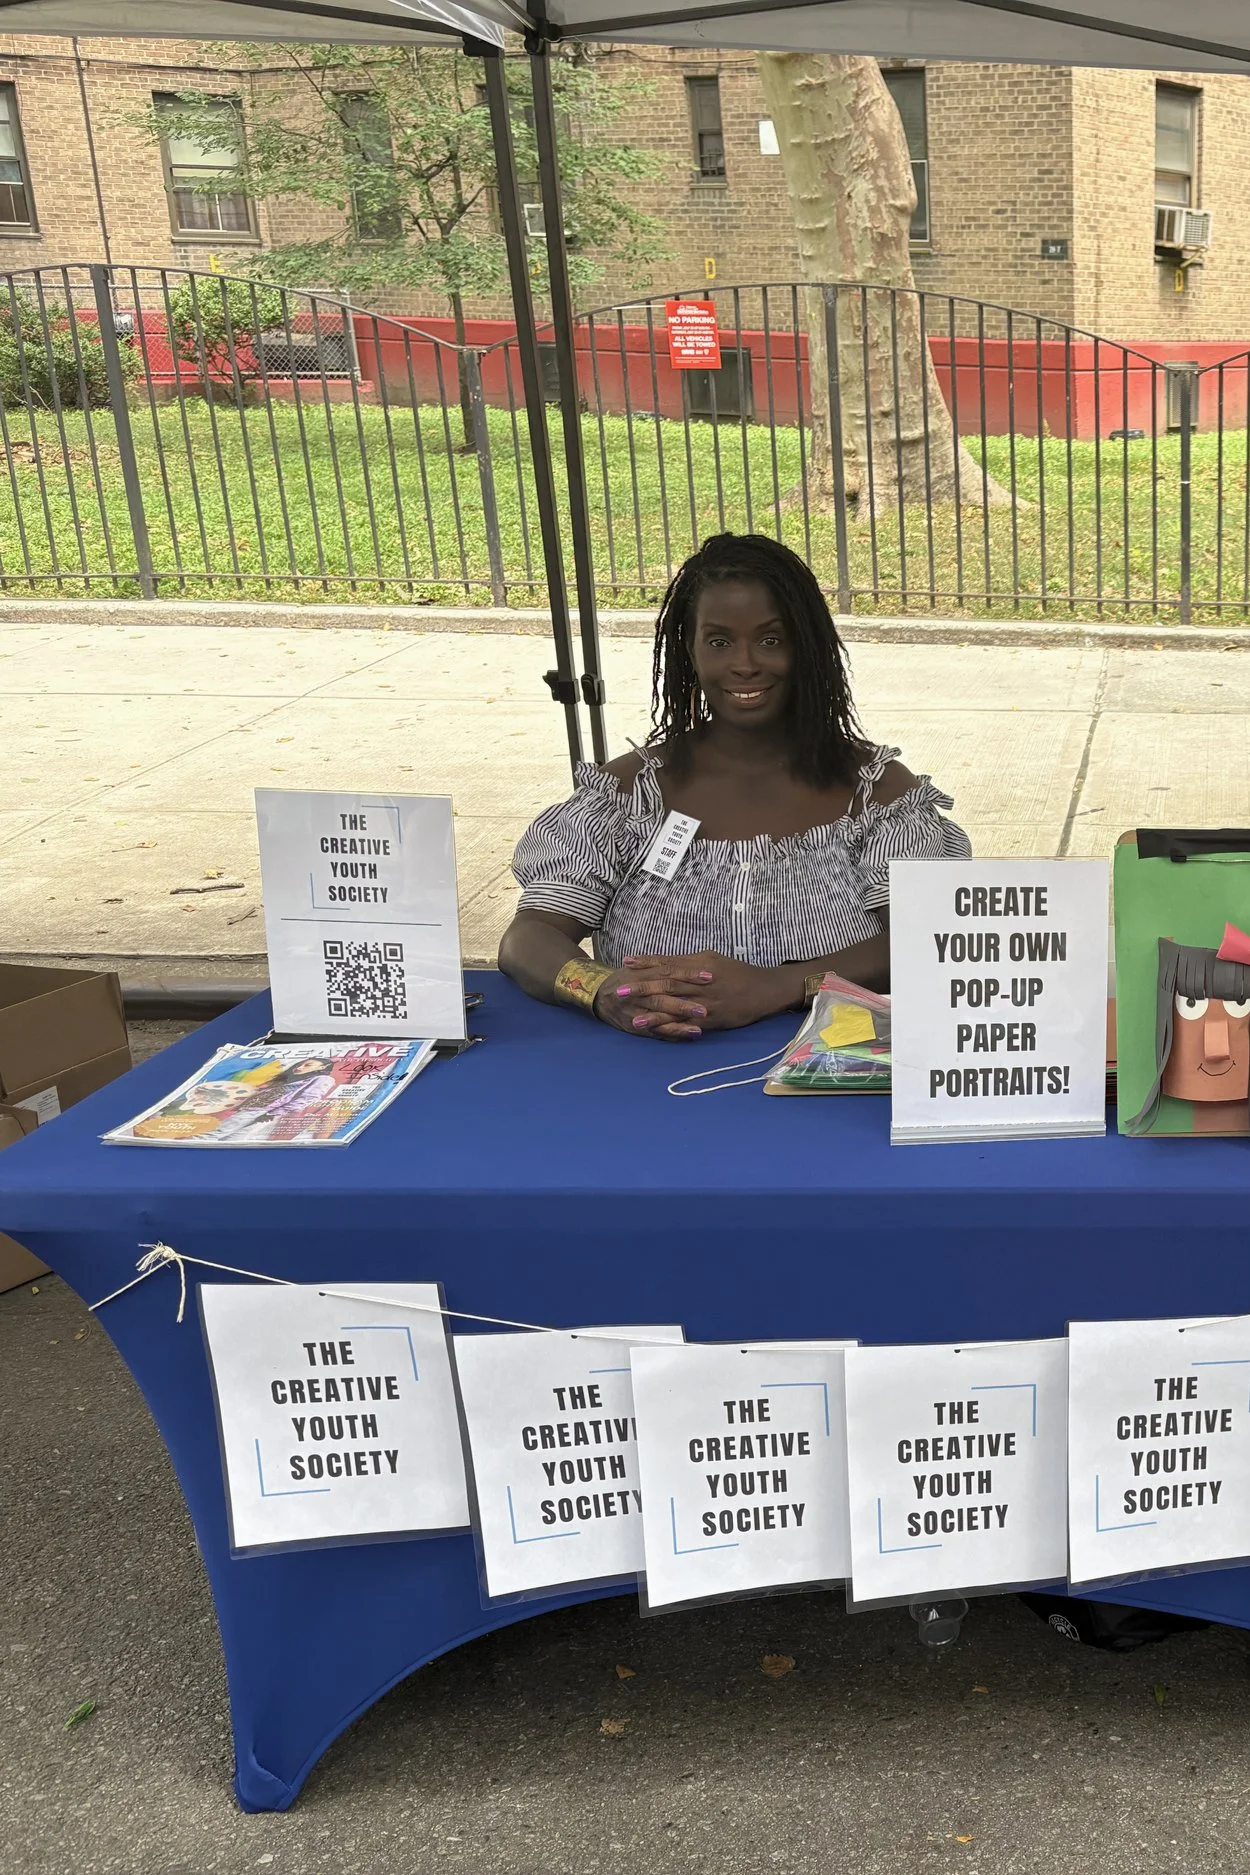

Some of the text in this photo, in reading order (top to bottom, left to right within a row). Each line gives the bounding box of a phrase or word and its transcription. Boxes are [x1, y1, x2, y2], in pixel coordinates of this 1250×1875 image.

[209, 253, 225, 273] E
[668, 316, 716, 324] NO PARKING
[339, 813, 366, 830] THE
[320, 836, 390, 855] CREATIVE
[660, 846, 678, 859] STAFF
[330, 861, 377, 879] YOUTH
[328, 885, 387, 903] SOCIETY
[954, 886, 1047, 916] CREATE
[933, 932, 1066, 962] YOUR OWN
[950, 977, 1043, 1008] POP-UP
[956, 1022, 1036, 1052] PAPER
[240, 1045, 414, 1060] CREATIVE
[929, 1065, 1069, 1098] PORTRAITS!
[302, 1340, 354, 1366] THE
[270, 1375, 399, 1404] CREATIVE
[552, 1384, 602, 1410] THE
[1153, 1376, 1197, 1401] THE
[723, 1398, 770, 1424] THE
[933, 1400, 978, 1425] THE
[1116, 1408, 1232, 1440] CREATIVE
[291, 1413, 378, 1441] YOUTH
[688, 1431, 810, 1462] CREATIVE
[897, 1432, 1015, 1463] CREATIVE
[1130, 1445, 1207, 1476] YOUTH
[289, 1449, 398, 1480] SOCIETY
[541, 1454, 626, 1486] YOUTH
[705, 1469, 787, 1498] YOUTH
[912, 1469, 991, 1499] YOUTH
[1123, 1480, 1222, 1514] SOCIETY
[701, 1502, 805, 1536] SOCIETY
[907, 1504, 1008, 1536] SOCIETY
